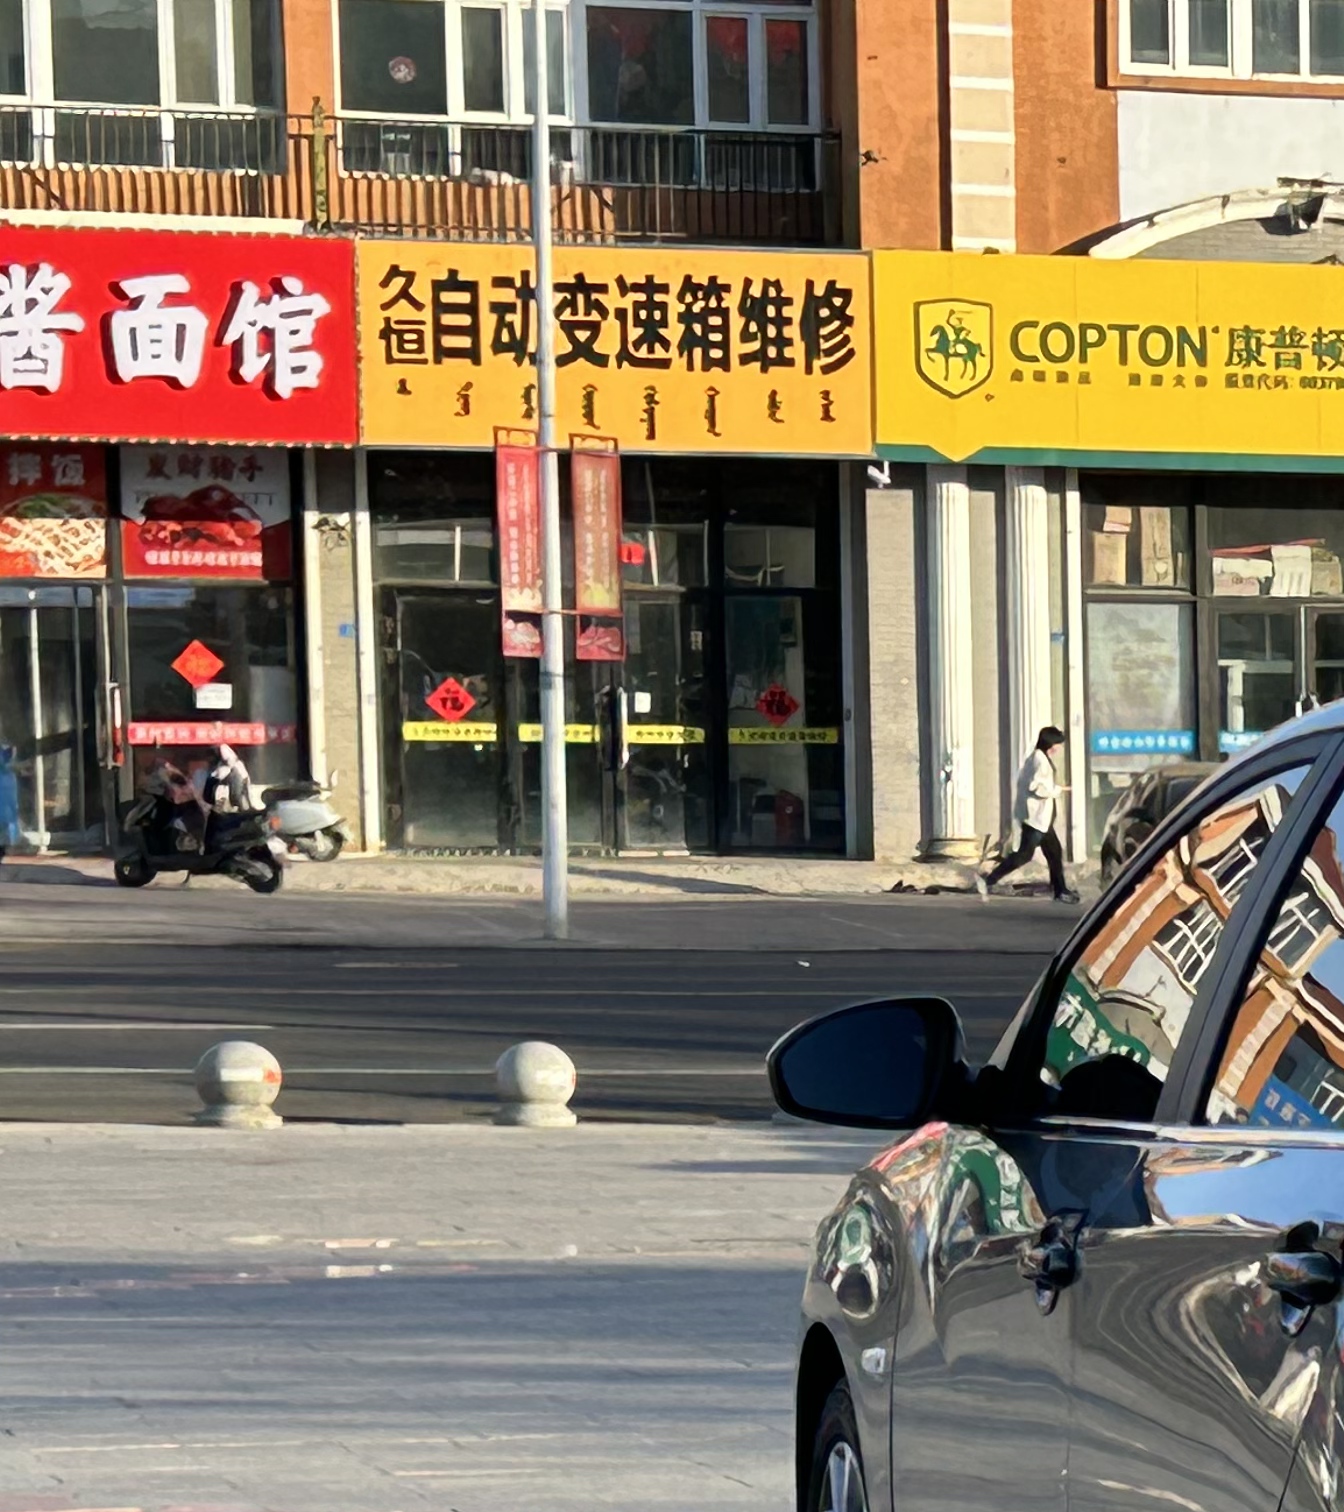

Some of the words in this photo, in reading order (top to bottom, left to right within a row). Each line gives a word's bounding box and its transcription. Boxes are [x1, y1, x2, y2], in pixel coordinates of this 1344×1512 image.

[0, 263, 331, 399] 酱面馆
[431, 269, 857, 375] 自动变速箱维修
[1010, 320, 1208, 367] COPTON
